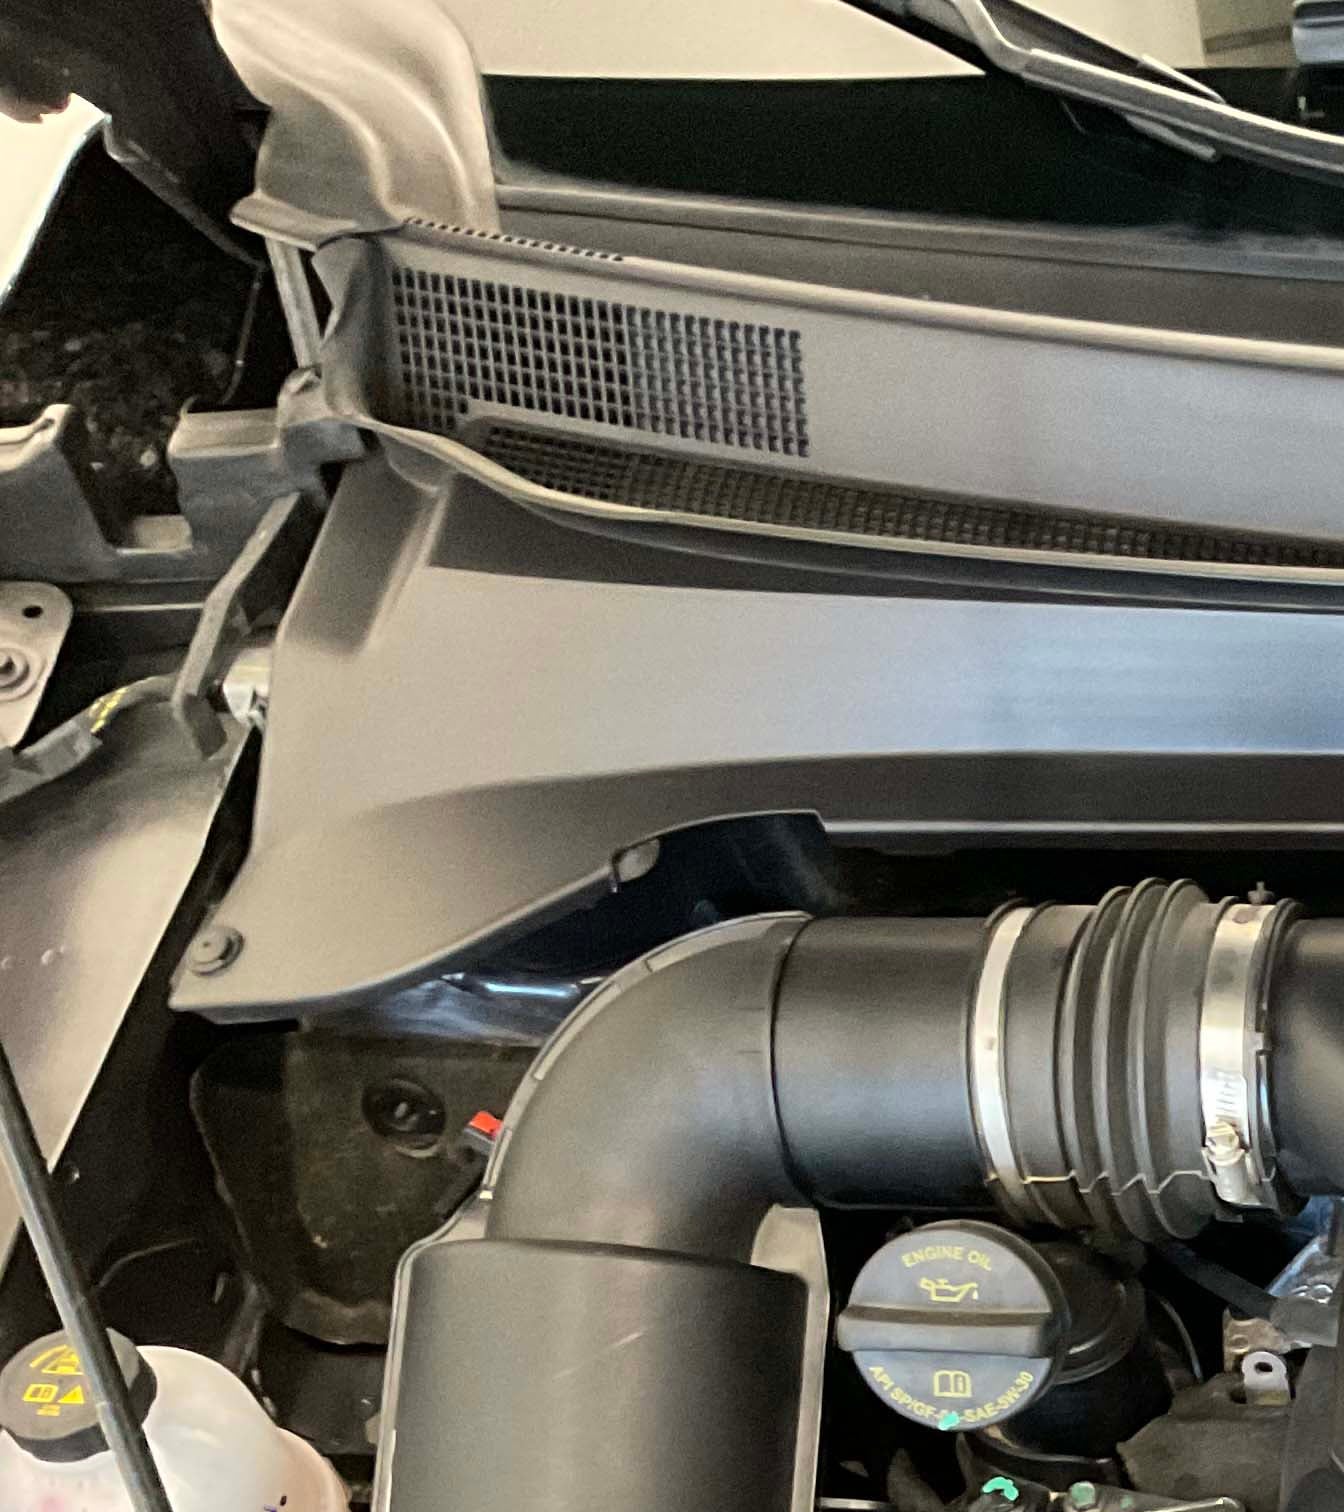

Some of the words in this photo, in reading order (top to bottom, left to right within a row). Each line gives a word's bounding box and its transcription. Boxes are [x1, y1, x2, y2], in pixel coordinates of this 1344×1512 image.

[901, 1246, 963, 1268] ENGINE
[968, 1249, 993, 1272] OIL
[869, 1365, 894, 1392] API
